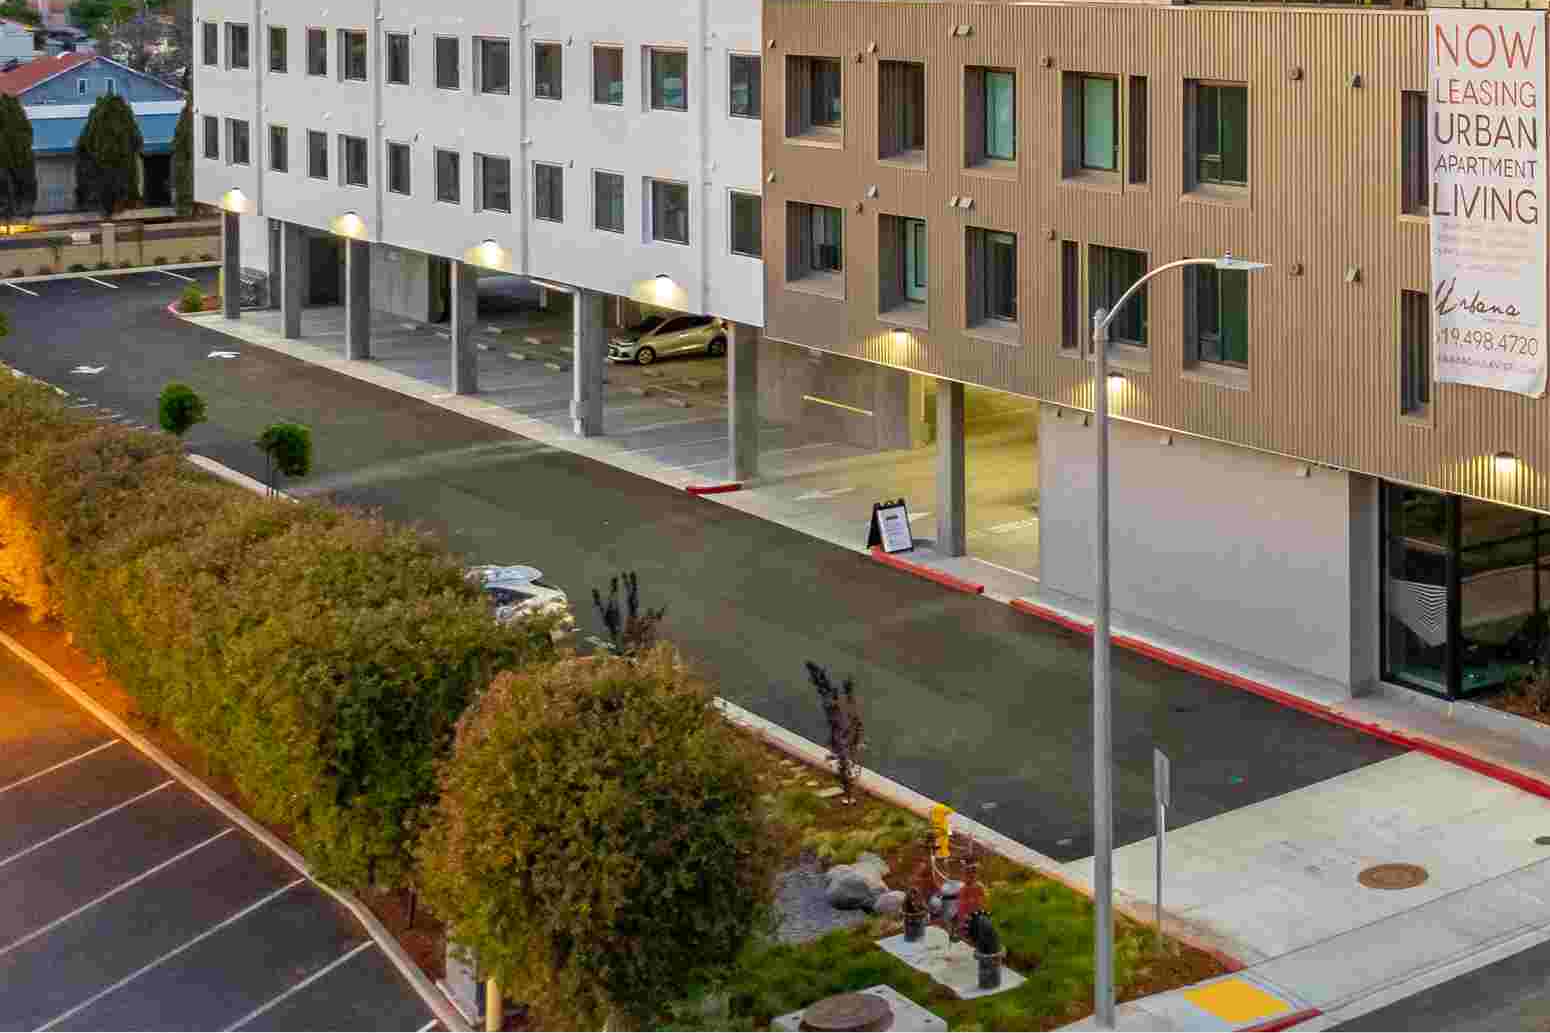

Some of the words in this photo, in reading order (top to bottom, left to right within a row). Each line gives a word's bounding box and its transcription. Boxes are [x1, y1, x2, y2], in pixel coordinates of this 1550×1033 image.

[1435, 23, 1537, 68] NOW
[1435, 78, 1537, 108] LEASING
[1434, 112, 1537, 150] URBAN
[1434, 154, 1537, 179] APARTMENT
[1433, 182, 1538, 224] LIVING
